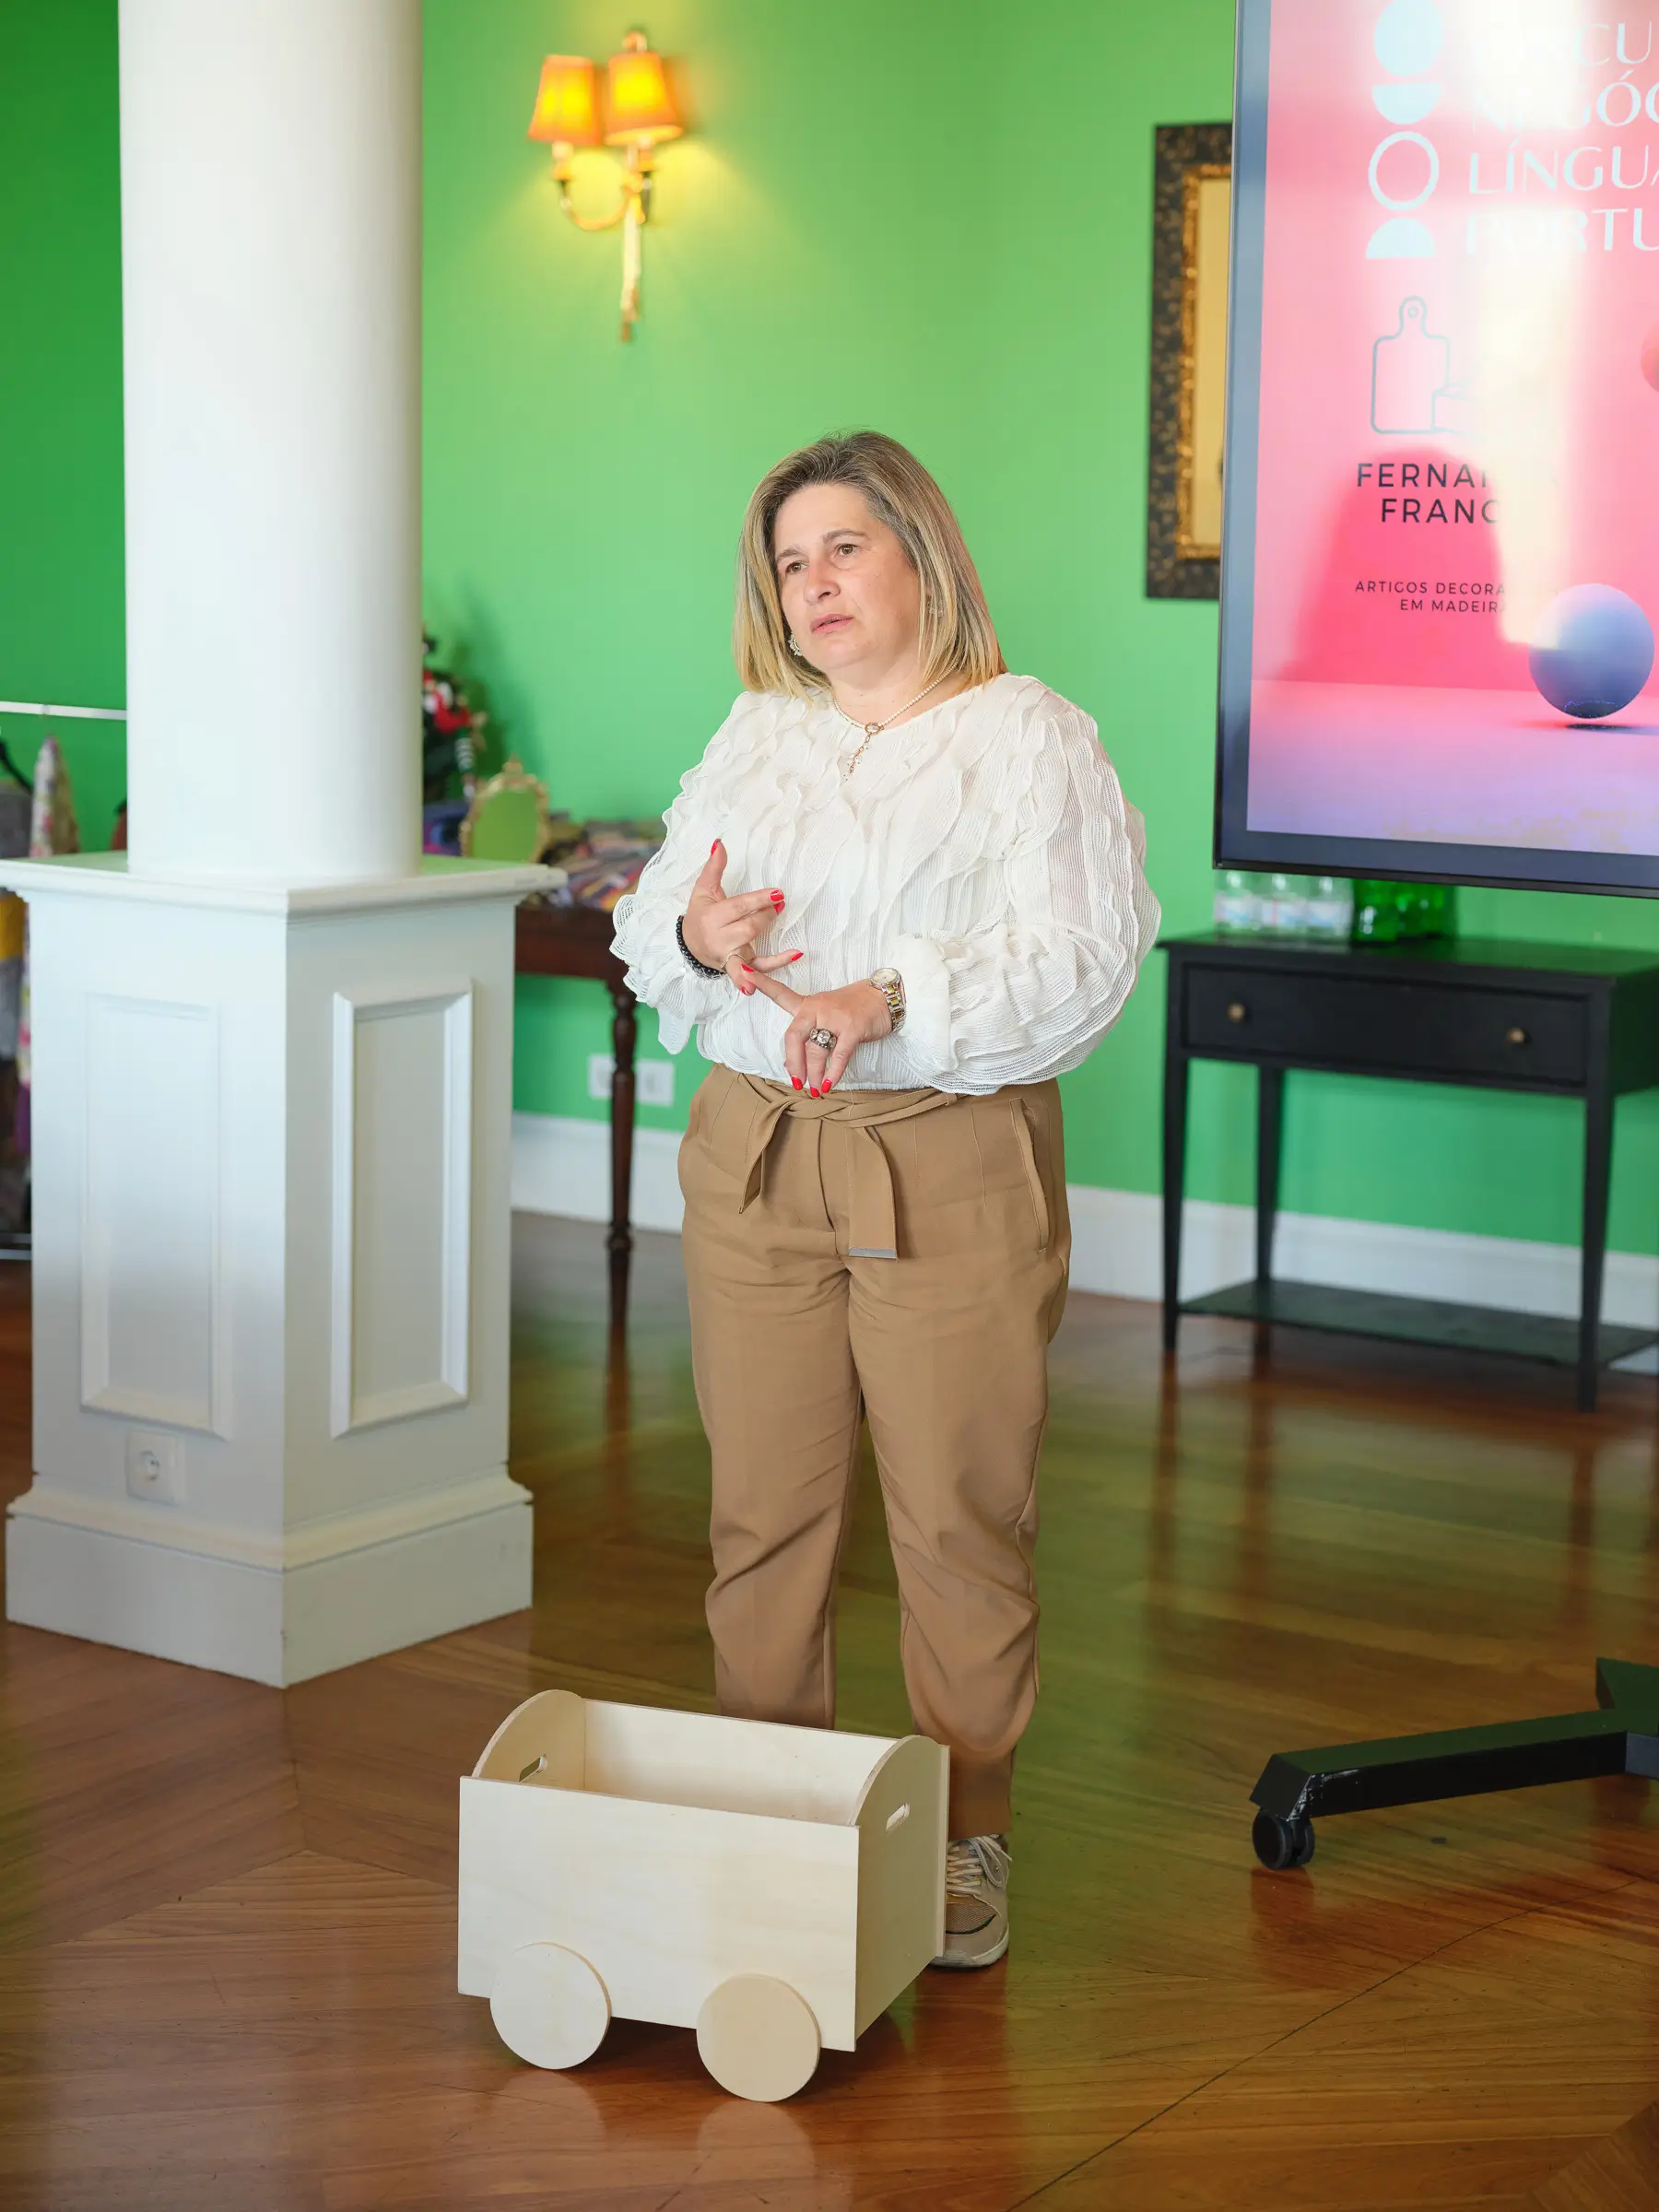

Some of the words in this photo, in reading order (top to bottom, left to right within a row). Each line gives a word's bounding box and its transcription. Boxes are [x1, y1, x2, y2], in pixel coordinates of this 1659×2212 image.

[1469, 137, 1659, 194] LÍNGU
[1357, 463, 1488, 488] FERNA
[1355, 581, 1428, 594] ARTIGOS
[1400, 599, 1424, 611] EM
